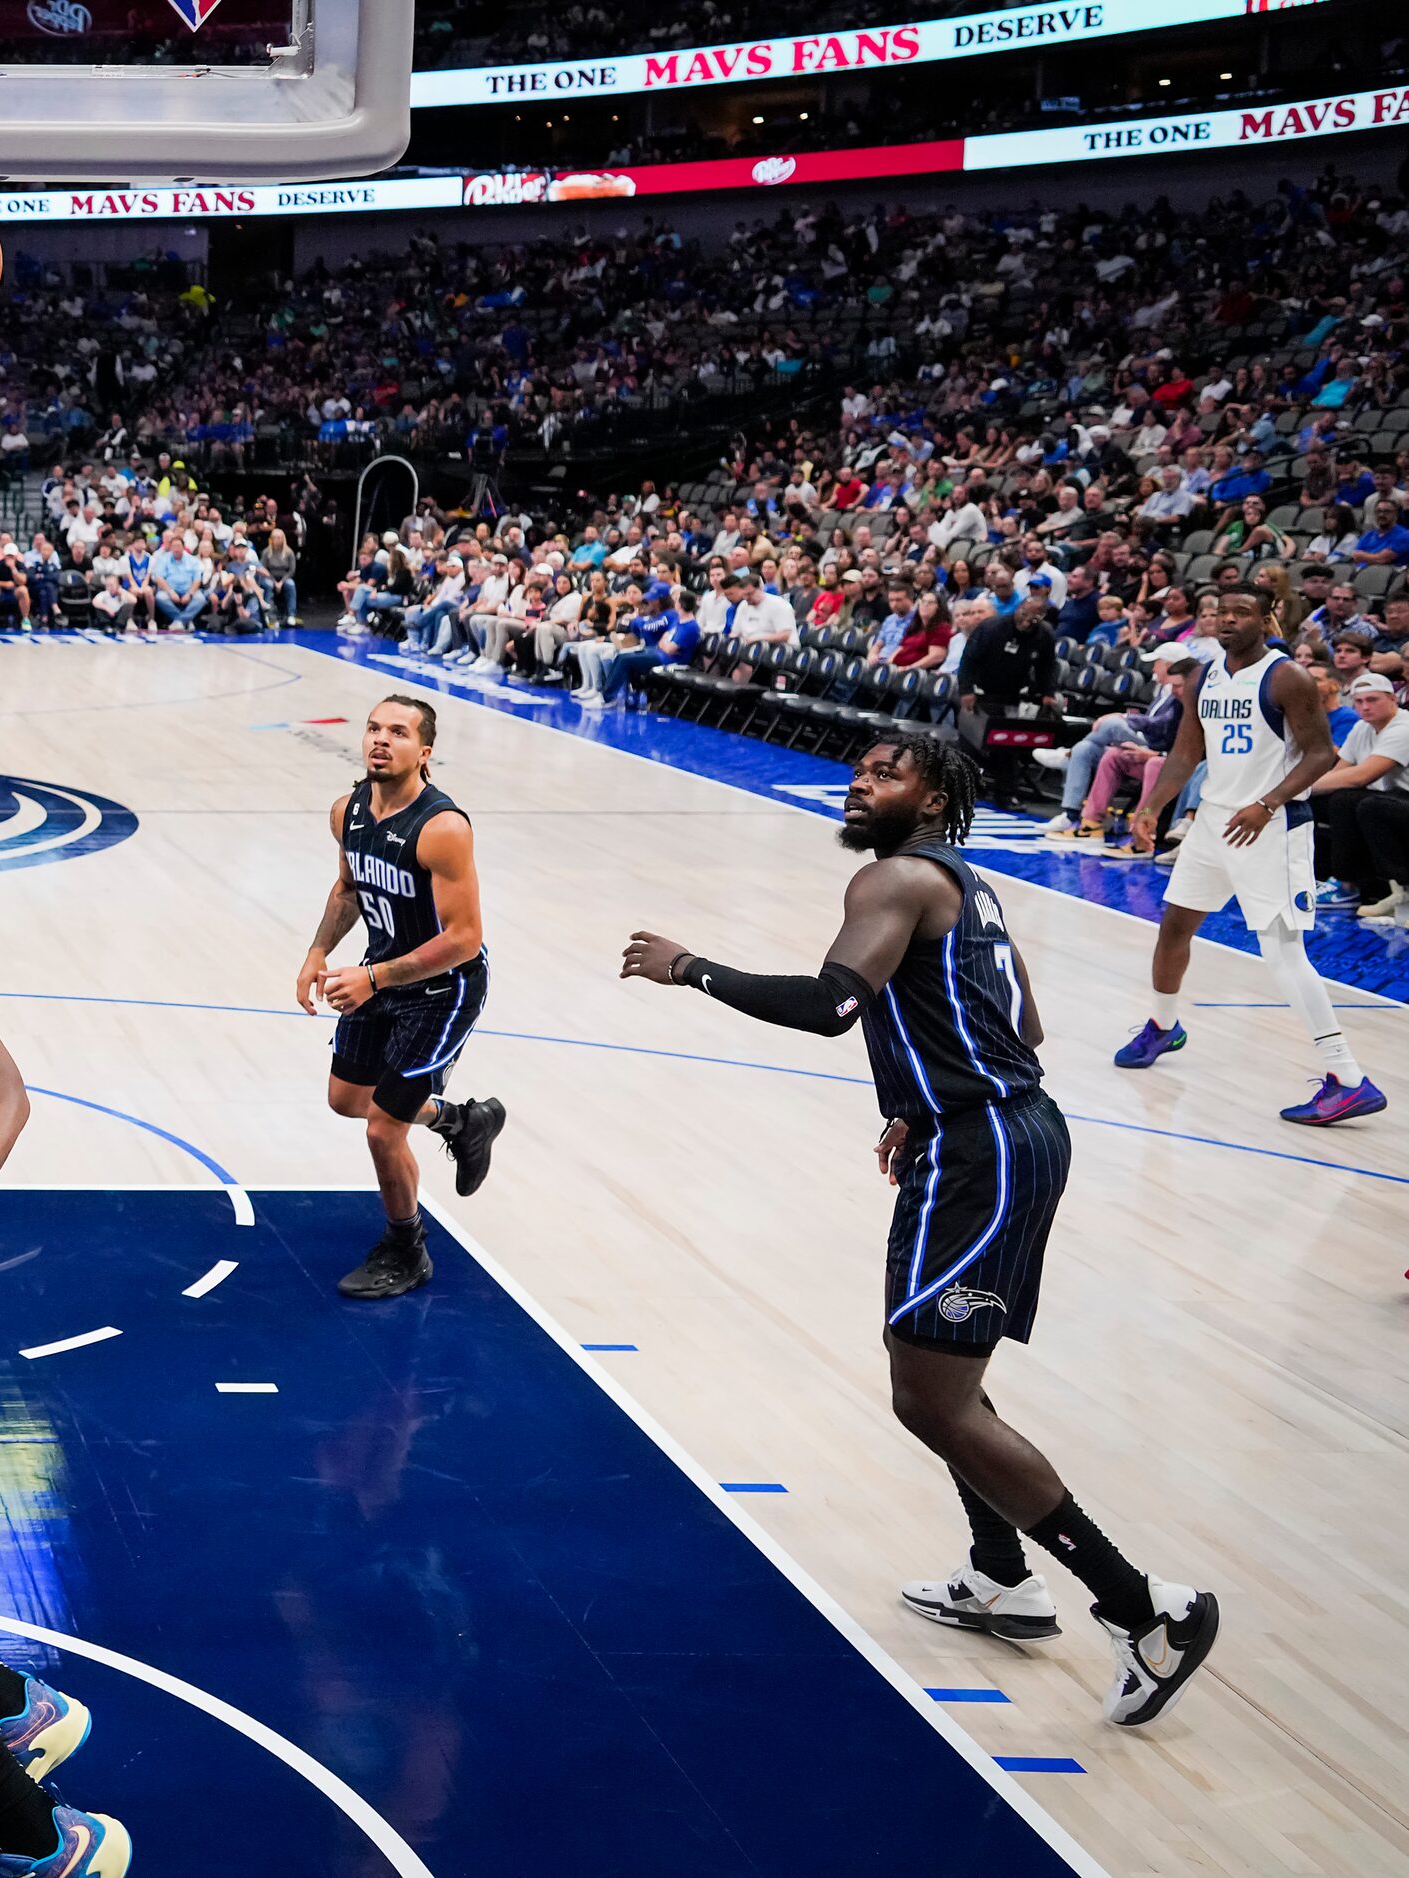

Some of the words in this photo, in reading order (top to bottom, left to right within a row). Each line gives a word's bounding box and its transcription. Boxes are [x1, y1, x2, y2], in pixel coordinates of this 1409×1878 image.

[954, 4, 1103, 48] DESERVE
[644, 44, 773, 87] MAVS
[791, 26, 920, 73] FANS
[486, 72, 547, 94] THE
[554, 67, 616, 89] ONE
[1238, 98, 1356, 141] MAVS
[1083, 129, 1142, 151] THE
[1148, 121, 1211, 145] ONE
[7, 198, 49, 213] ONE
[70, 194, 159, 215] MAVS
[172, 190, 256, 214] FANS
[277, 188, 376, 207] DESERVE
[1200, 698, 1252, 720] DALLAS
[1220, 723, 1254, 755] 25
[345, 850, 416, 898] RLANDO
[357, 889, 396, 939] 50
[993, 941, 1024, 1038] 7
